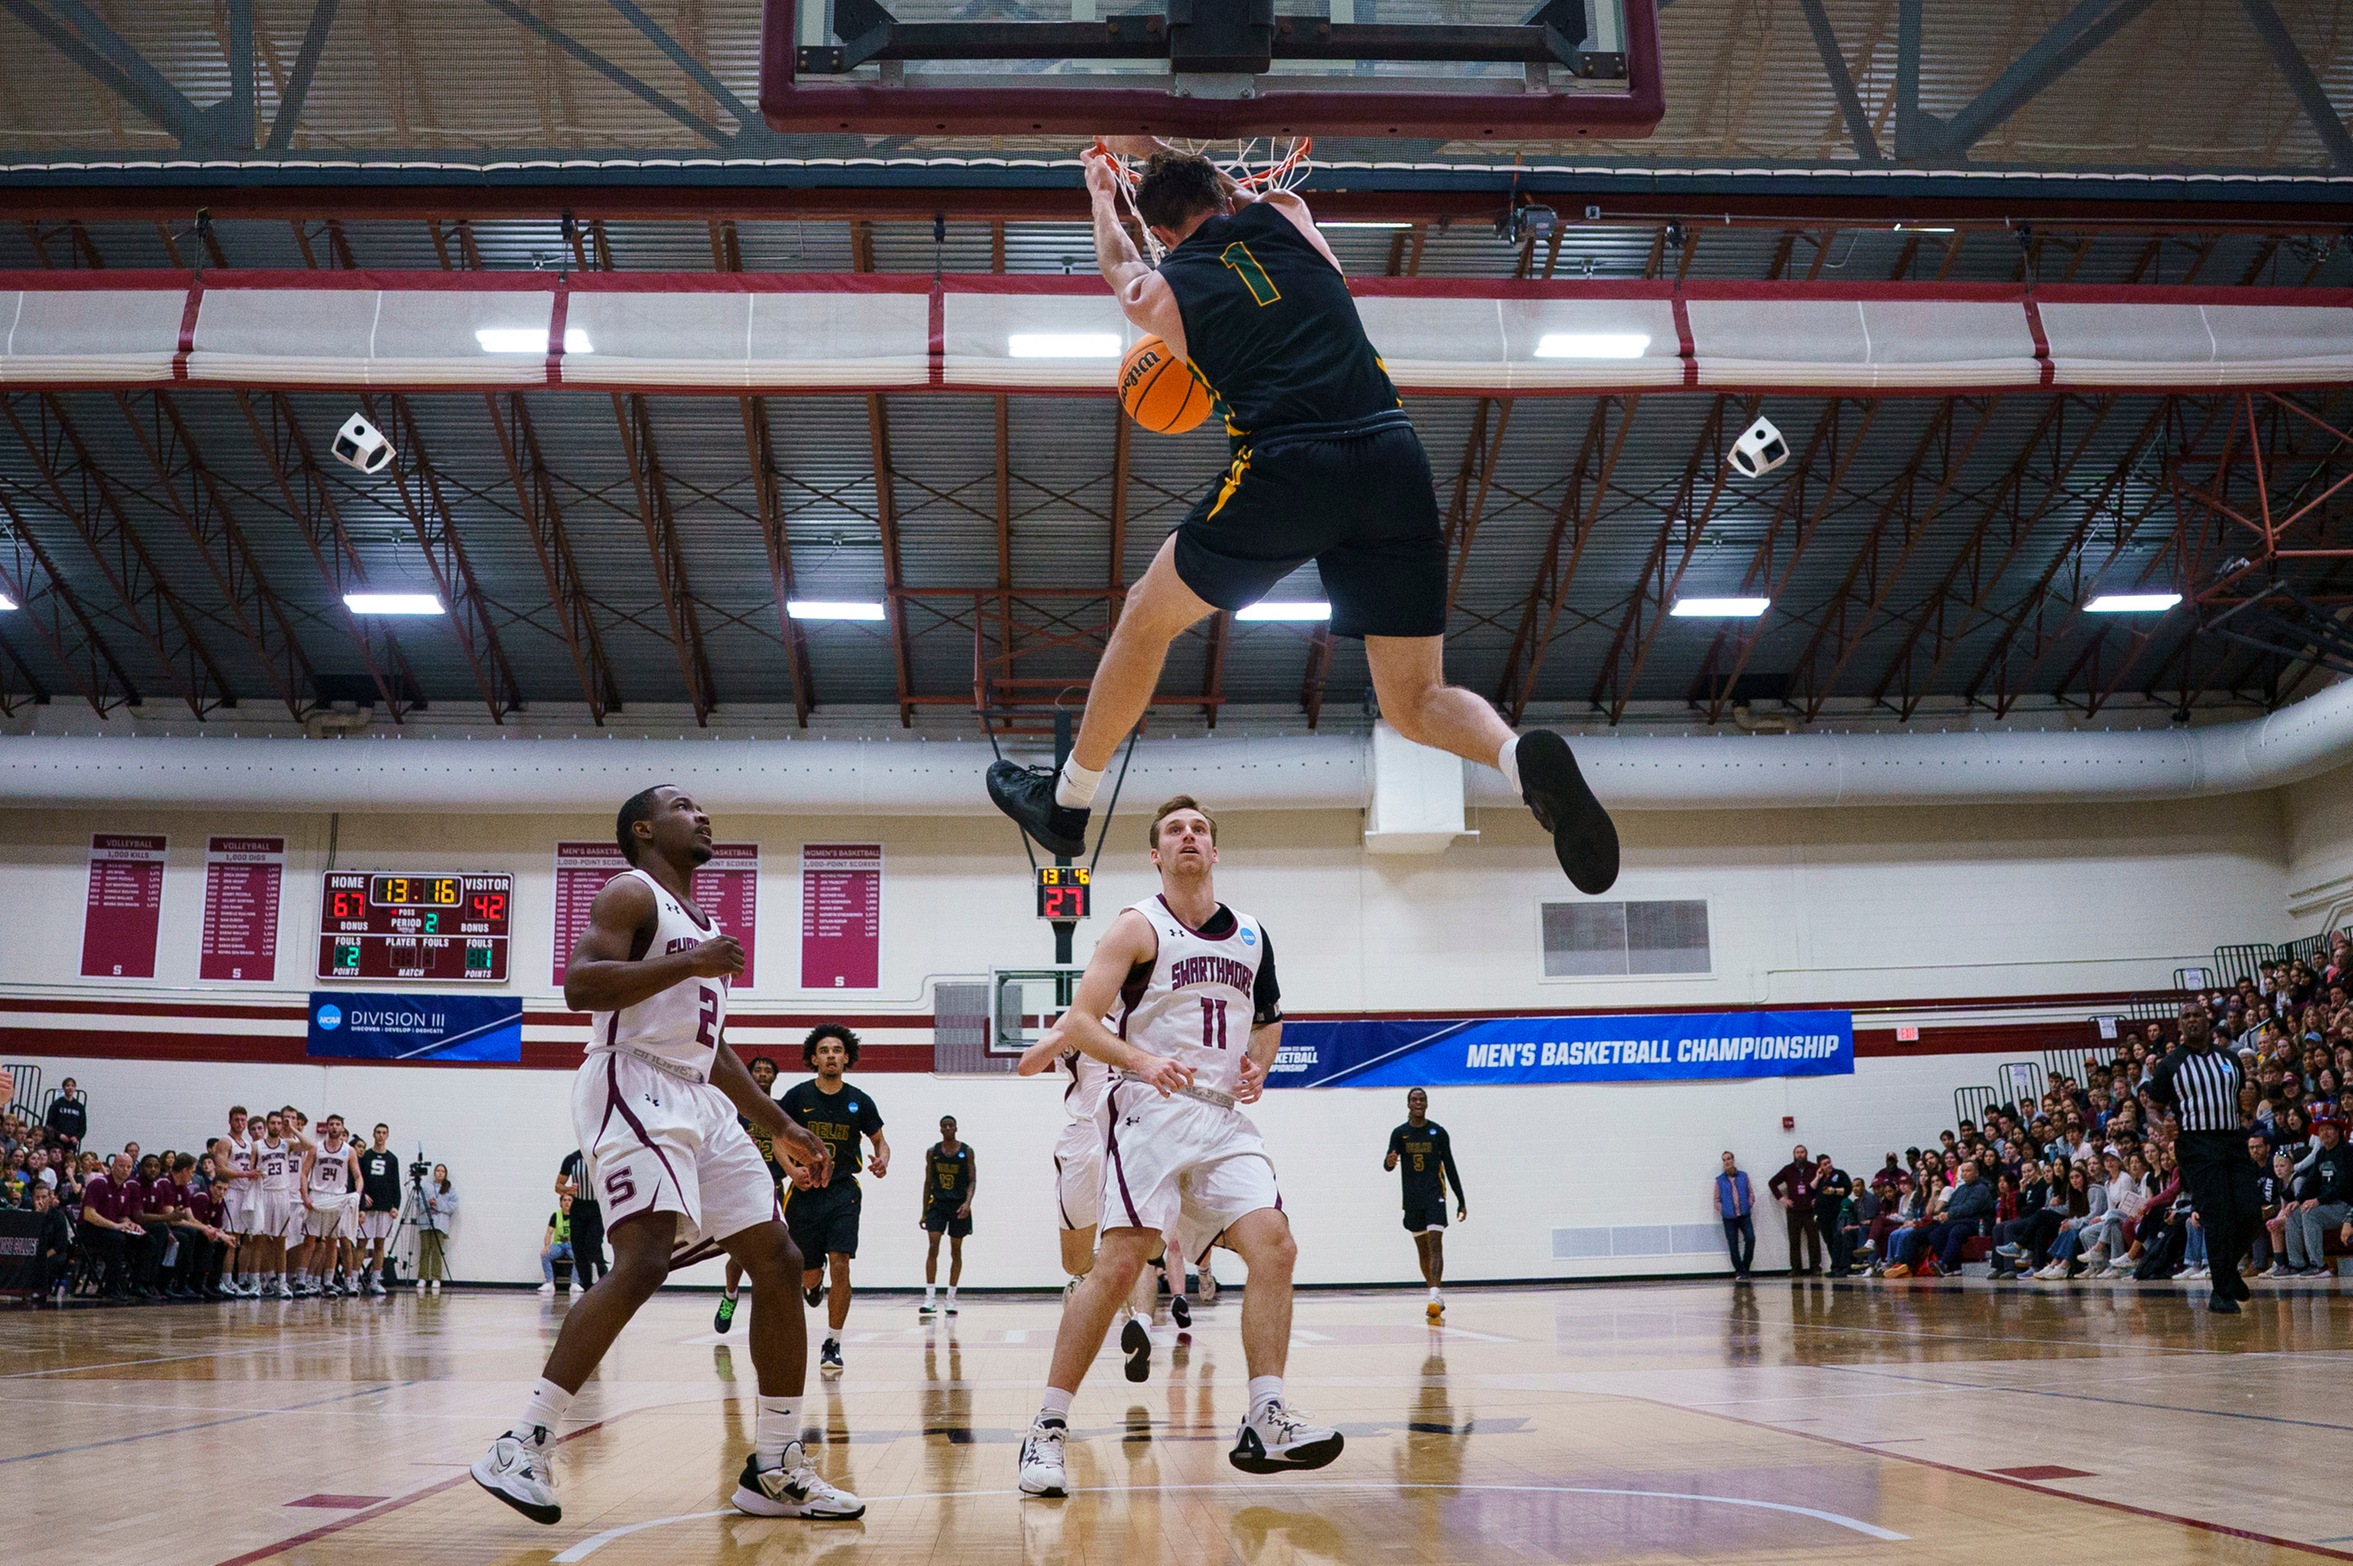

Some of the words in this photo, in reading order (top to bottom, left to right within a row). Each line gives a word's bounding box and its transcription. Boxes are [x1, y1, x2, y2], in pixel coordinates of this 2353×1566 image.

[1220, 241, 1281, 306] 1
[106, 839, 153, 848] VOLLEYBALL
[222, 842, 270, 850] VOLLEYBALL
[332, 876, 364, 888] HOME
[465, 878, 509, 890] VISITOR
[1043, 868, 1058, 884] 13
[334, 893, 364, 917] 67
[474, 895, 504, 919] 42
[1045, 887, 1082, 916] 27
[340, 921, 368, 931] BONUS
[391, 918, 422, 928] PERIOD
[425, 912, 438, 933] 2
[460, 923, 490, 933] BONUS
[335, 936, 362, 946] FOULS
[386, 938, 416, 947] PLAYER
[422, 938, 449, 948] FOULS
[466, 938, 493, 948] FOULS
[347, 947, 360, 966] 2
[113, 964, 122, 975] S
[232, 968, 242, 978] S
[332, 966, 360, 976] POINTS
[398, 968, 425, 978] MATCH
[465, 969, 492, 979] POINTS
[834, 976, 845, 986] S
[1171, 956, 1254, 1000] SWARTHMORE
[319, 1016, 341, 1024] NCAA
[351, 1010, 426, 1026] DIVISION
[432, 1014, 445, 1027] III
[696, 985, 718, 1050] 2
[1201, 997, 1228, 1050] 11
[1900, 1028, 1916, 1040] EXIT
[1274, 1052, 1319, 1064] KETBALL
[1466, 1042, 1536, 1068] MEN'S
[1541, 1038, 1672, 1066] BASKETBALL
[1677, 1034, 1839, 1062] CHAMPIONSHIP
[808, 1121, 850, 1140] DELHI
[268, 1162, 282, 1176] 23
[289, 1160, 299, 1174] 50
[370, 1159, 386, 1176] S
[1412, 1154, 1424, 1172] 5
[322, 1167, 338, 1182] 24
[605, 1166, 637, 1210] S
